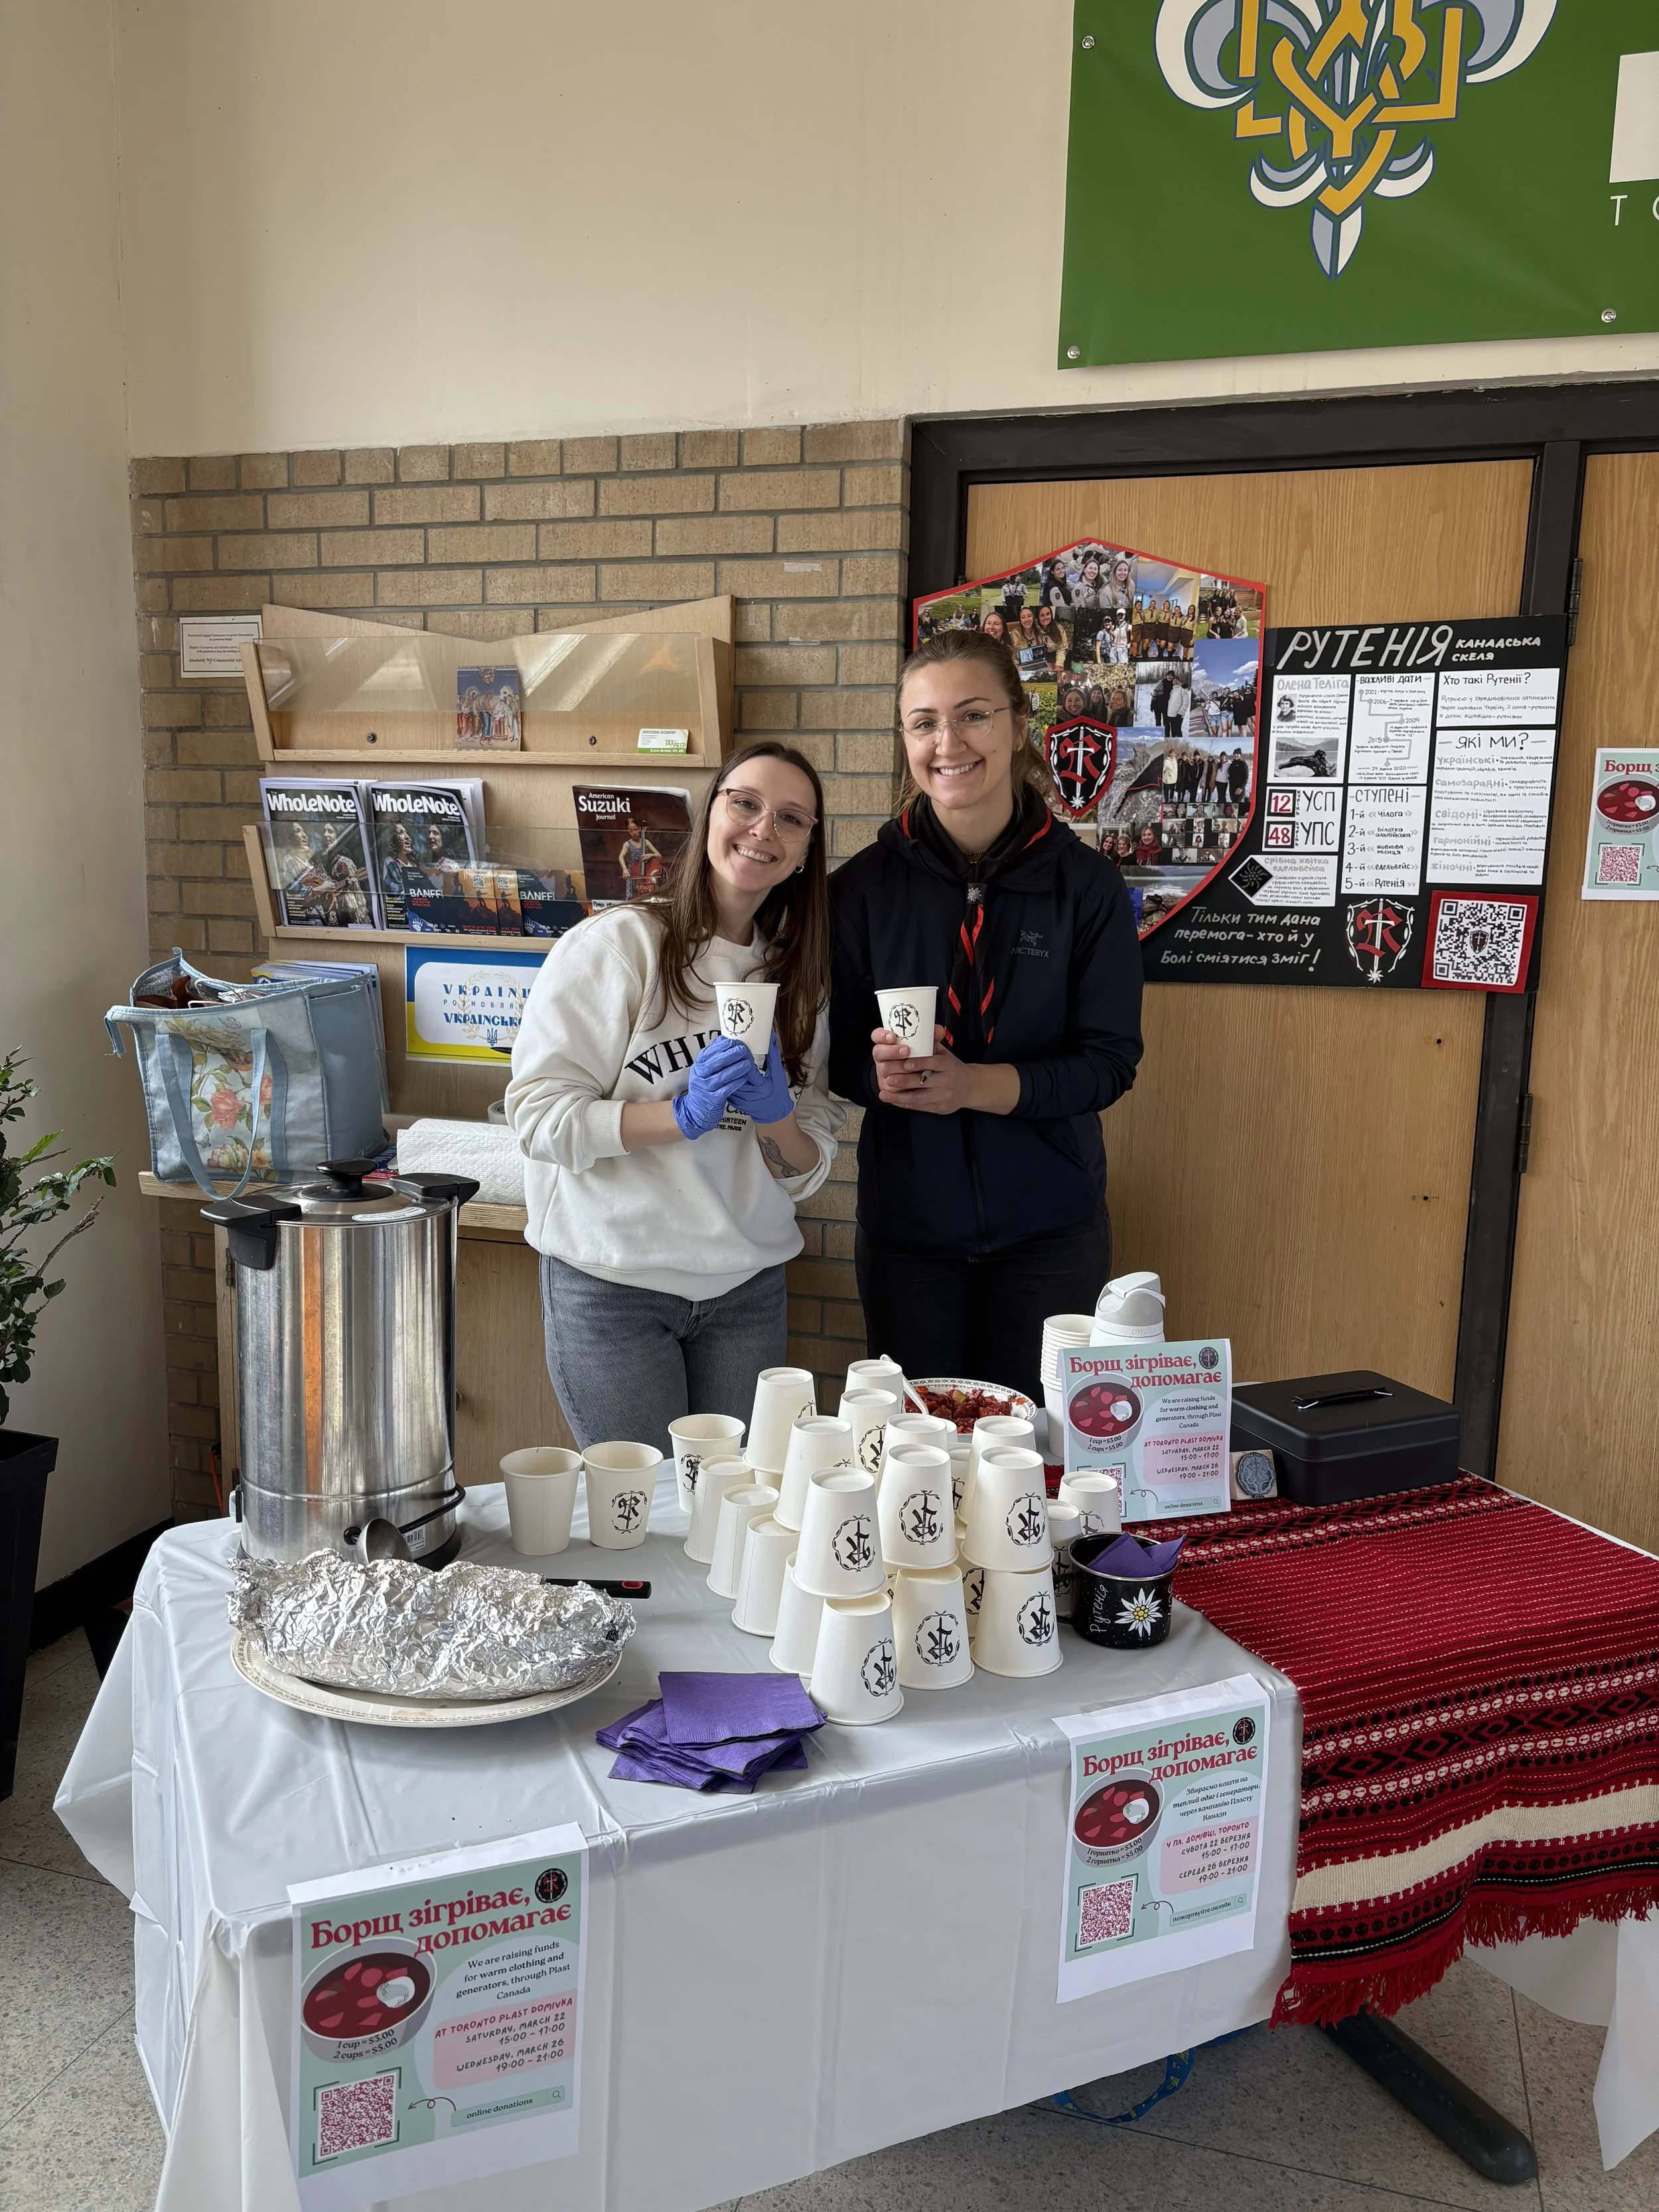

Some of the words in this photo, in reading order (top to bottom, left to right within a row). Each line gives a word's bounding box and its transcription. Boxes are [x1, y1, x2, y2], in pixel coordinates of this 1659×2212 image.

[1276, 625, 1453, 670] РУТЕНІЯ
[1455, 636, 1541, 648] КАНАДСЬКА
[1452, 652, 1494, 662] СКЕЛЯ
[1277, 678, 1311, 691] Олена
[1313, 676, 1349, 689] Теліга
[1443, 675, 1460, 685] Хто
[1463, 674, 1482, 684] такі
[1604, 760, 1652, 775] Борщ
[267, 793, 357, 813] WholeNote
[372, 793, 461, 816] WholeNote
[579, 795, 631, 813] Suzuki
[1272, 795, 1291, 813] 12
[1303, 790, 1335, 812] УСП
[1350, 809, 1364, 820] 1-й
[1268, 827, 1291, 844] 48
[1301, 822, 1334, 846] УПС
[1348, 825, 1365, 838] 2-й
[1347, 842, 1366, 855] 3-й
[1374, 879, 1405, 888] Рутенія
[1191, 907, 1240, 925] Тільки
[1247, 915, 1277, 925] тим
[1280, 915, 1321, 927] дана
[1257, 930, 1284, 942] хто
[1301, 931, 1315, 949] у
[1196, 950, 1267, 966] сміятися
[443, 984, 531, 998] УКРАЇНЦ
[444, 999, 524, 1009] РОЗМОВЛЯЮ
[443, 1013, 522, 1027] УКРАЇНСЬК
[719, 1117, 747, 1126] HIRTEEN
[1069, 1357, 1123, 1376] Борщ
[1125, 1353, 1196, 1373] зігріває,
[1129, 1371, 1222, 1390] допомагає
[1107, 1435, 1121, 1444] $3.00
[1109, 1441, 1123, 1451] $5.00
[1090, 1584, 1111, 1633] Рутенія
[1083, 1749, 1144, 1777] Борщ
[1147, 1731, 1230, 1760] зігріває,
[1149, 1745, 1258, 1784] допомагає
[1173, 1797, 1200, 1808] теплий
[1220, 1783, 1261, 1799] генератори,
[1187, 1783, 1218, 1795] Збираємо
[1218, 1779, 1240, 1788] кошти
[1179, 1808, 1197, 1818] через
[1197, 1800, 1230, 1813] кампанію
[1230, 1795, 1254, 1806] Пласту
[1202, 1811, 1227, 1821] Канади
[1186, 1830, 1216, 1844] ДОМІВЦІ,
[1218, 1822, 1249, 1833] ТОРОНТО
[1181, 1842, 1207, 1855] СУБОТА
[1220, 1832, 1250, 1844] БЕРЕЗНЯ
[1201, 1848, 1221, 1860] 15:00
[1230, 1841, 1250, 1852] 17:00
[1179, 1866, 1205, 1879] СЕРЕДА
[1218, 1856, 1248, 1868] БЕРЕЗНЯ
[1198, 1872, 1218, 1883] 19:00
[1228, 1864, 1248, 1874] 21:00
[311, 1913, 403, 1949] Борщ
[408, 1887, 531, 1928] зігріває,
[1173, 1907, 1210, 1922] пожертвуйте
[413, 1903, 572, 1958] допомагає
[468, 1959, 484, 1969] We
[484, 1956, 500, 1966] are
[501, 1947, 533, 1962] raising
[534, 1941, 559, 1954] funds
[464, 1972, 479, 1983] for
[479, 1967, 508, 1979] warm
[508, 1957, 547, 1972] clothing
[547, 1953, 564, 1962] and
[456, 1980, 510, 1999] generators,
[511, 1970, 548, 1987] through
[549, 1963, 571, 1974] Plast
[496, 1986, 531, 2000] Canada
[435, 2028, 447, 2038] AT
[451, 2016, 496, 2033] TORONTO
[499, 2008, 528, 2023] PLAST
[532, 1998, 573, 2014] DOMIVKA
[466, 2026, 516, 2043] SATURDAY,
[519, 2016, 550, 2030] MARCH
[553, 2012, 565, 2021] 22
[368, 2029, 394, 2044] $3.00
[499, 2032, 526, 2045] 15:00
[538, 2023, 565, 2035] 17:00
[341, 2051, 363, 2060] cups
[372, 2037, 397, 2054] $5.00
[457, 2052, 514, 2072] WEDNESDAY,
[517, 2043, 548, 2057] MARCH
[551, 2037, 564, 2048] 26
[496, 2059, 524, 2072] 19:00
[537, 2049, 563, 2063] 21:00
[467, 2106, 492, 2119] online
[493, 2098, 533, 2112] donations
